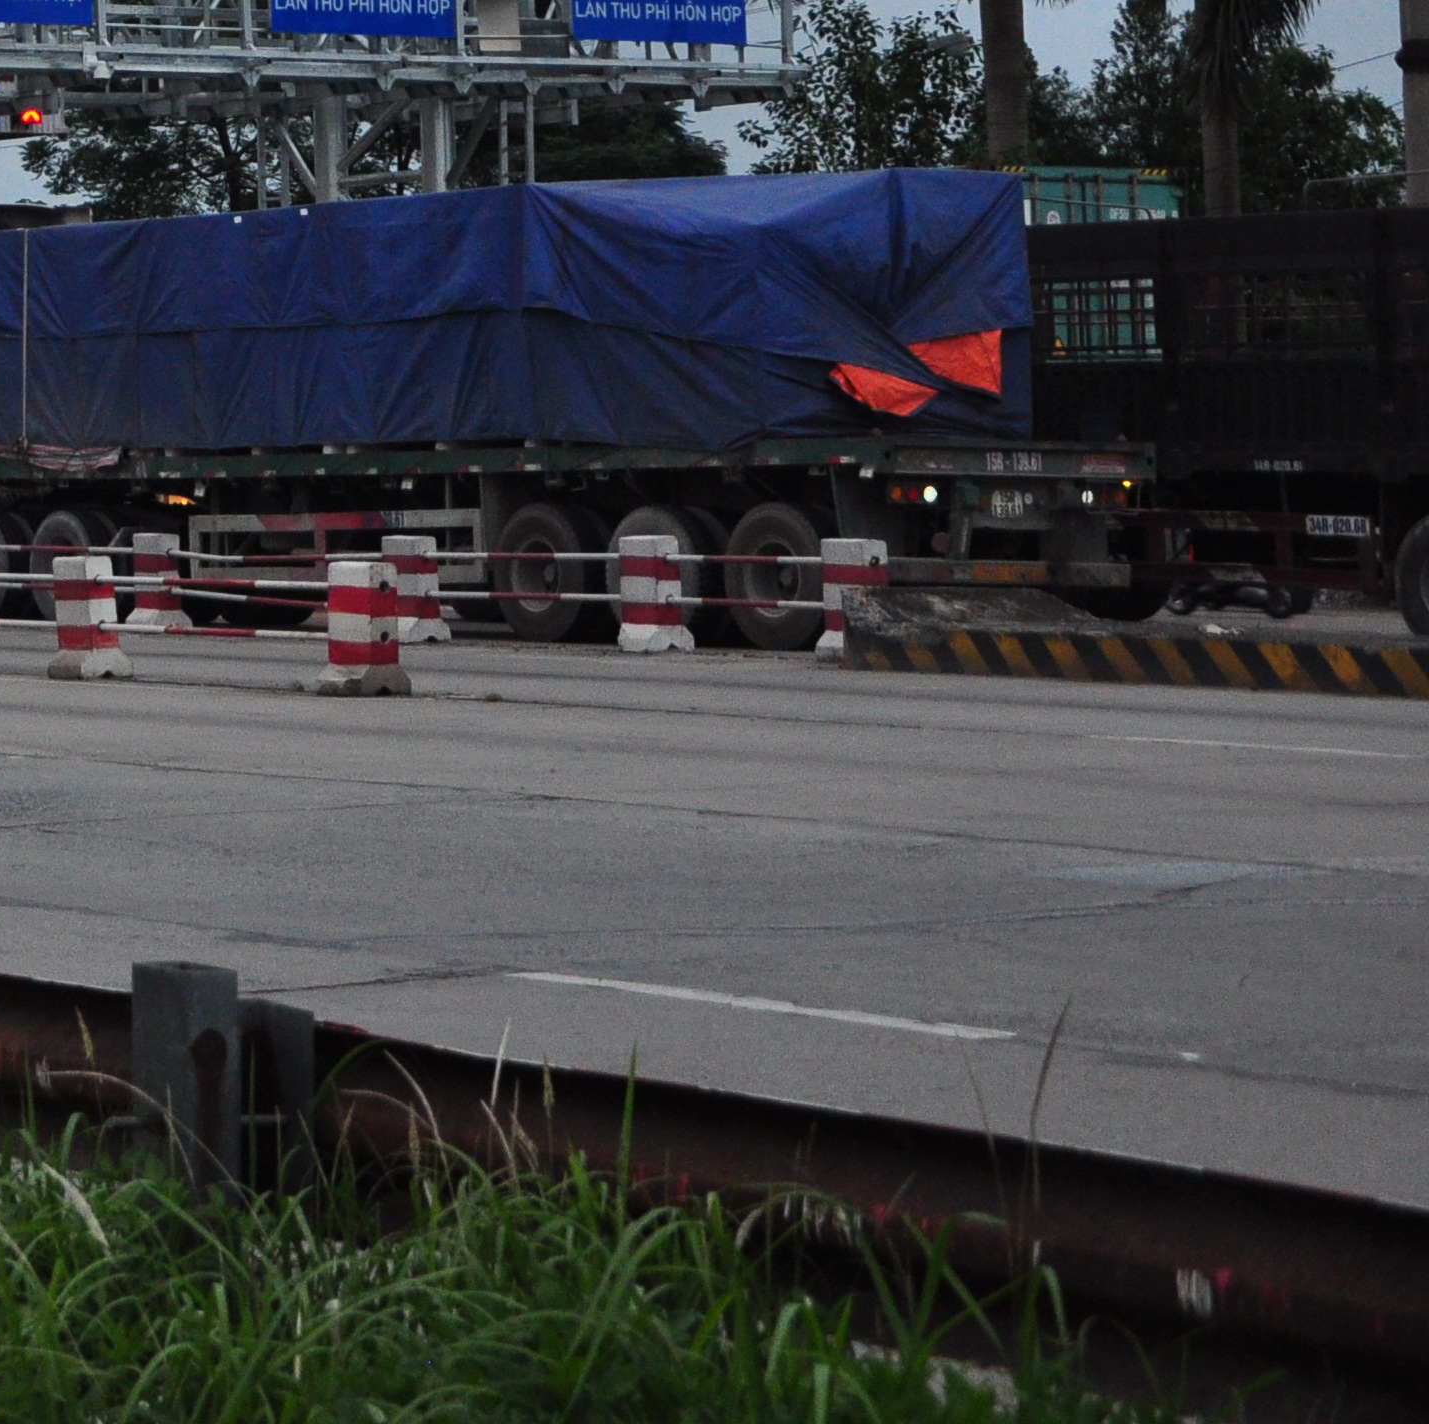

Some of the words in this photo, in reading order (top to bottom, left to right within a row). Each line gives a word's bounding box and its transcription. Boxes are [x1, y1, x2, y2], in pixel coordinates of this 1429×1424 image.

[610, 1, 641, 19] THU
[645, 0, 670, 20] PHÍ
[711, 5, 741, 26] HỢP
